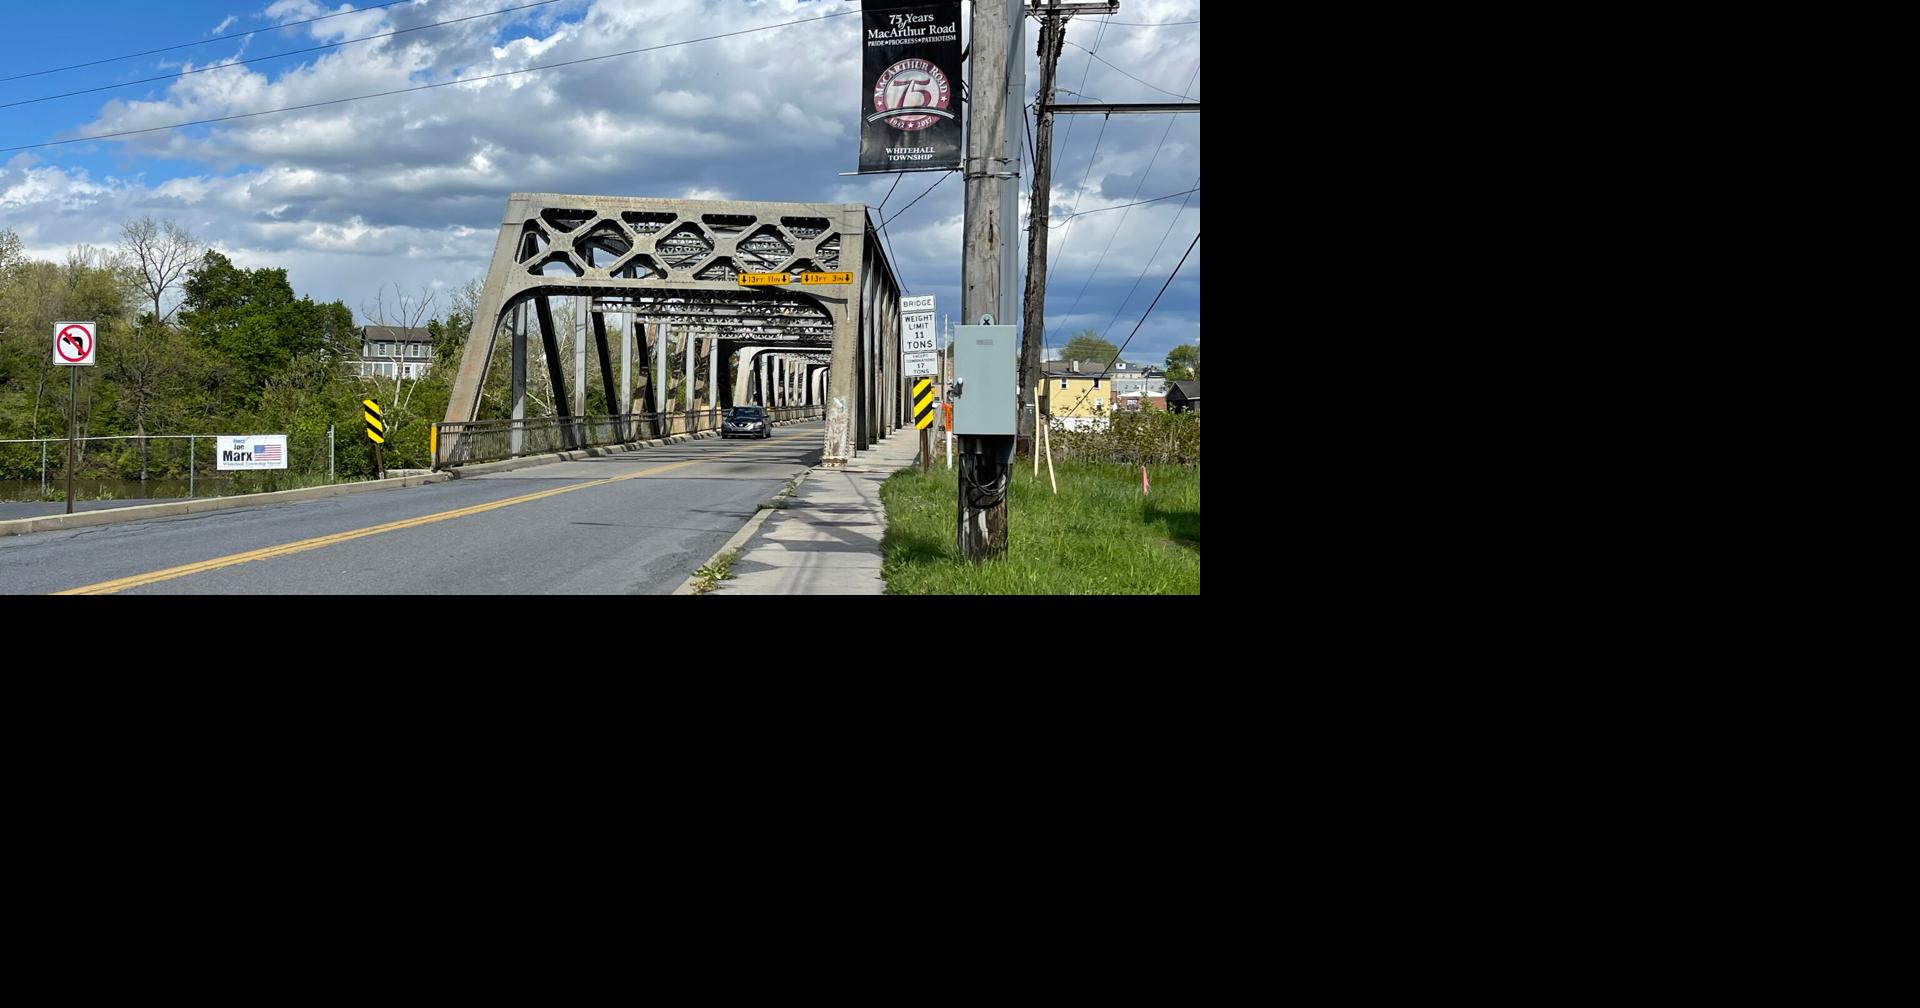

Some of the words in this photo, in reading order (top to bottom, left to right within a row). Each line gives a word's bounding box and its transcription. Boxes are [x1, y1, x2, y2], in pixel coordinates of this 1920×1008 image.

[889, 14, 903, 25] 75
[906, 13, 934, 23] Years
[897, 20, 908, 29] of
[868, 26, 926, 38] MacArthur
[929, 22, 956, 34] Road
[929, 66, 949, 93] ROAD
[892, 79, 932, 108] 75
[889, 117, 905, 128] 1942
[885, 146, 936, 154] WHITEHALL
[903, 299, 932, 307] BRIDGE
[905, 314, 932, 322] WEIGHT
[907, 340, 933, 349] TONS
[223, 451, 252, 461] Marx
